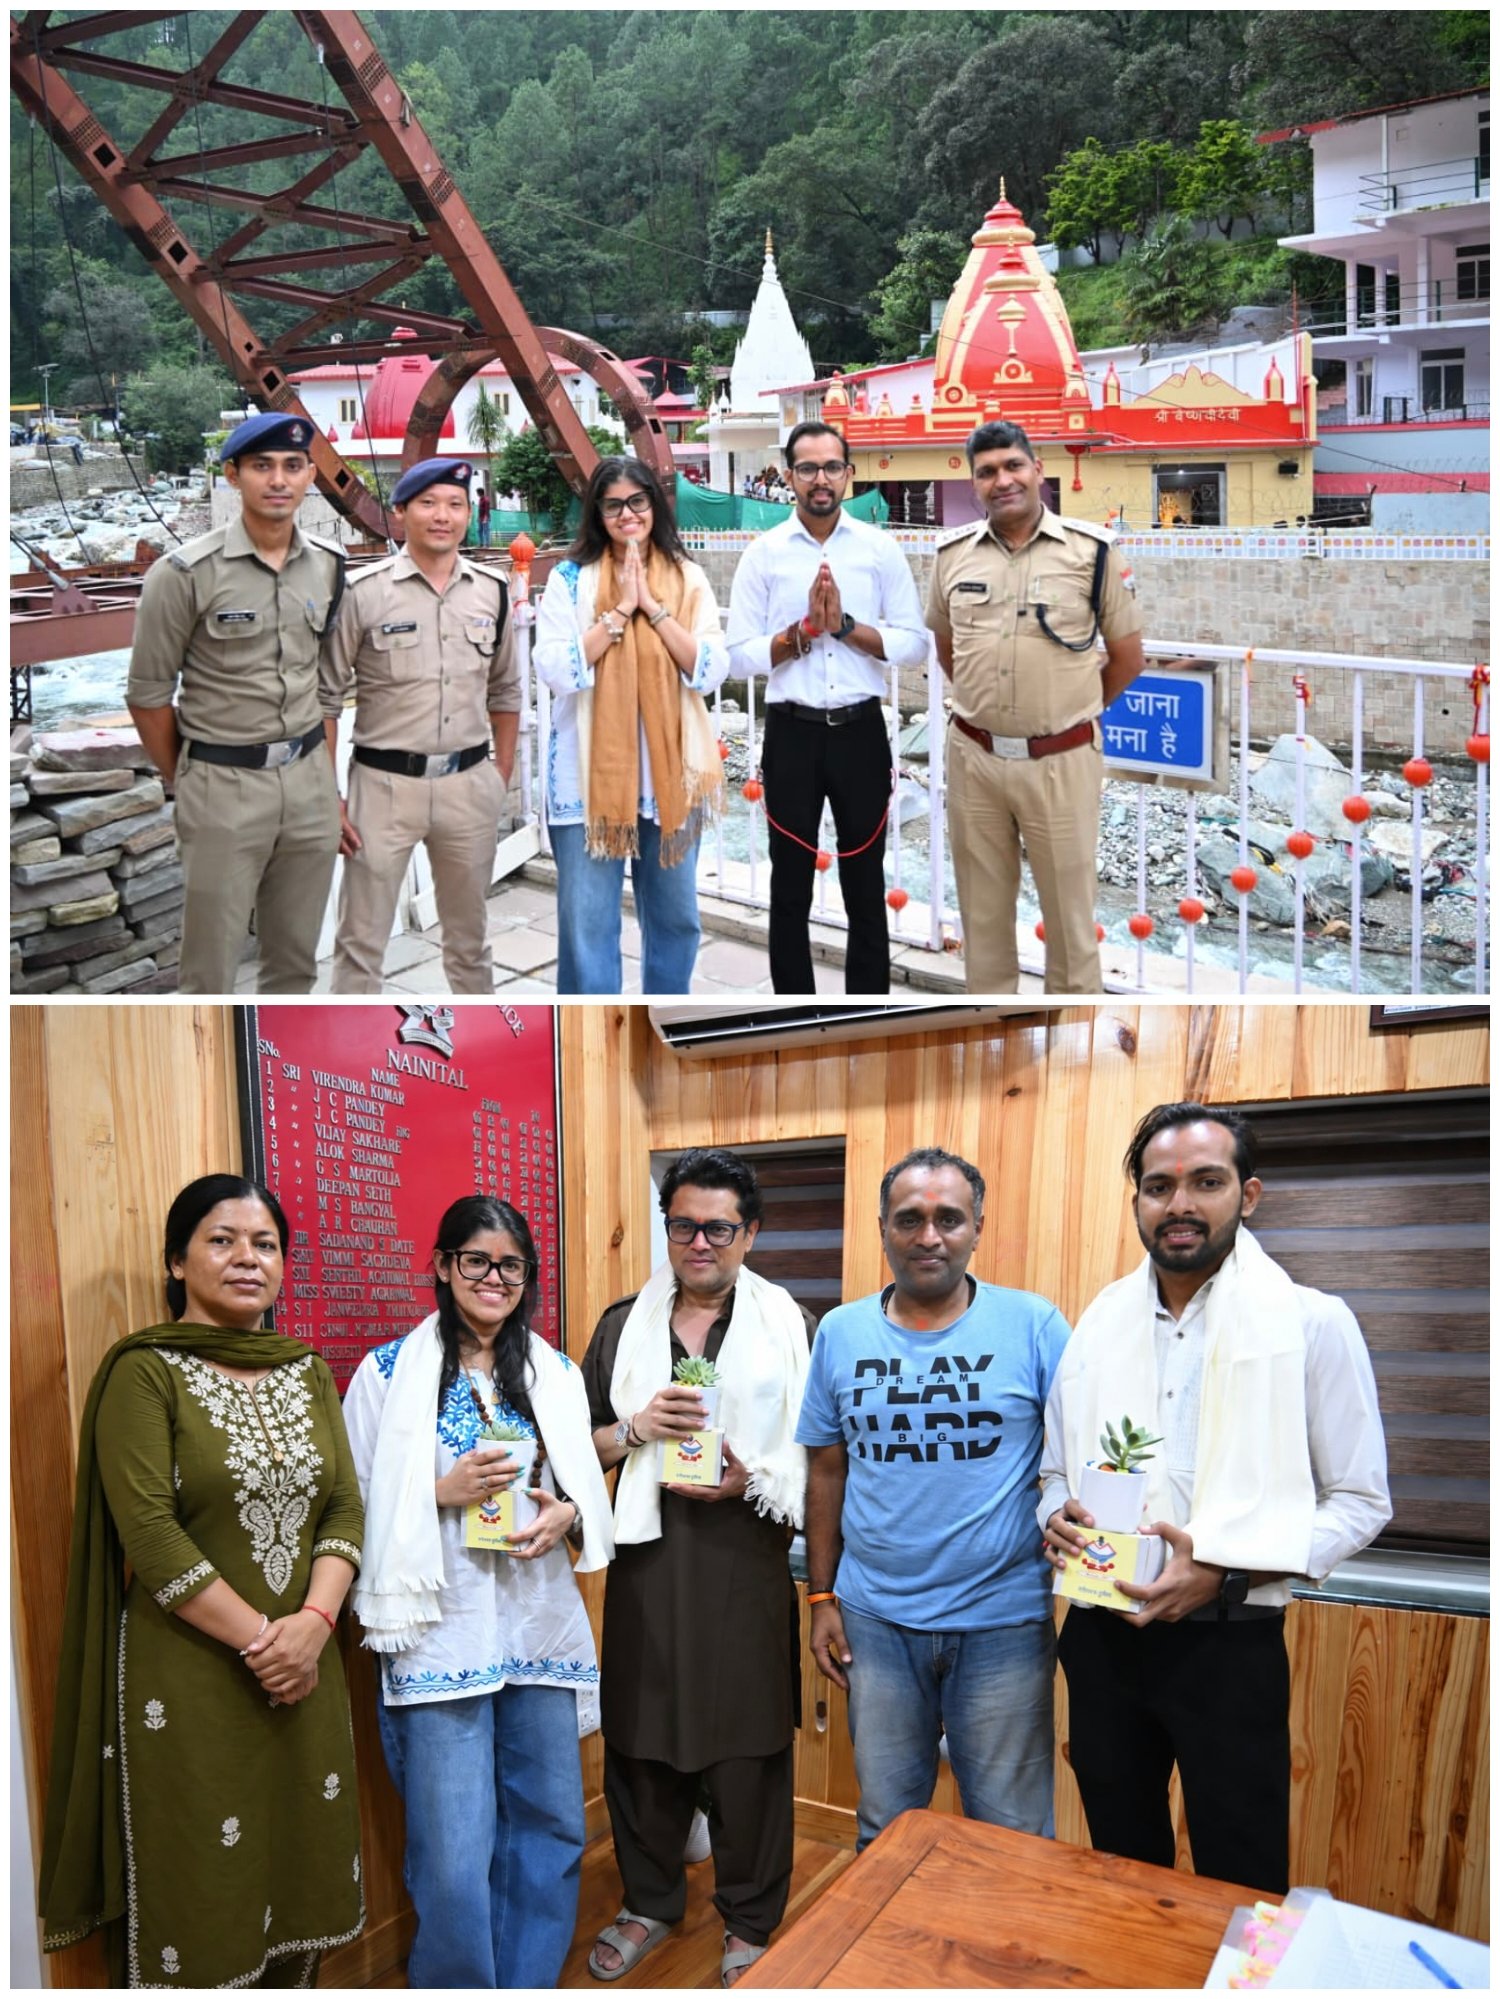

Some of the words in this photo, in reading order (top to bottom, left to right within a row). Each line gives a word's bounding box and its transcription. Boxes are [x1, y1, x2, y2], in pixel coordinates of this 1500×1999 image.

[1124, 690, 1181, 719] जाना
[1105, 725, 1148, 753] मना
[1159, 722, 1178, 759] है
[266, 1060, 272, 1075] 1
[282, 1063, 300, 1080] SRI
[311, 1070, 366, 1095] VIRENDRA
[370, 1085, 405, 1106] KUMAR
[370, 1068, 400, 1087] NAME
[387, 1048, 469, 1090] NAINITAL
[267, 1079, 274, 1093] 2
[313, 1088, 320, 1103] J
[329, 1092, 337, 1106] C
[345, 1095, 385, 1117] PANDEY
[268, 1096, 275, 1111] 3
[314, 1106, 321, 1120] J
[330, 1110, 338, 1124] C
[346, 1112, 386, 1133] PANDEY
[269, 1115, 276, 1129] 4
[314, 1123, 346, 1143] VIJAY
[352, 1131, 402, 1154] SAKHARE
[271, 1135, 278, 1150] 5
[315, 1142, 345, 1160] ALOK
[352, 1149, 395, 1169] SHARMA
[272, 1153, 279, 1167] 6
[333, 1163, 341, 1177] S
[272, 1171, 280, 1186] 7
[316, 1178, 360, 1197] DEEPAN
[318, 1195, 328, 1211] M
[335, 1198, 341, 1212] S
[319, 1214, 328, 1229] A
[853, 1354, 995, 1407] PLAY
[876, 1373, 969, 1386] DREAM
[848, 1410, 1003, 1463] HARD
[898, 1432, 947, 1443] BIG
